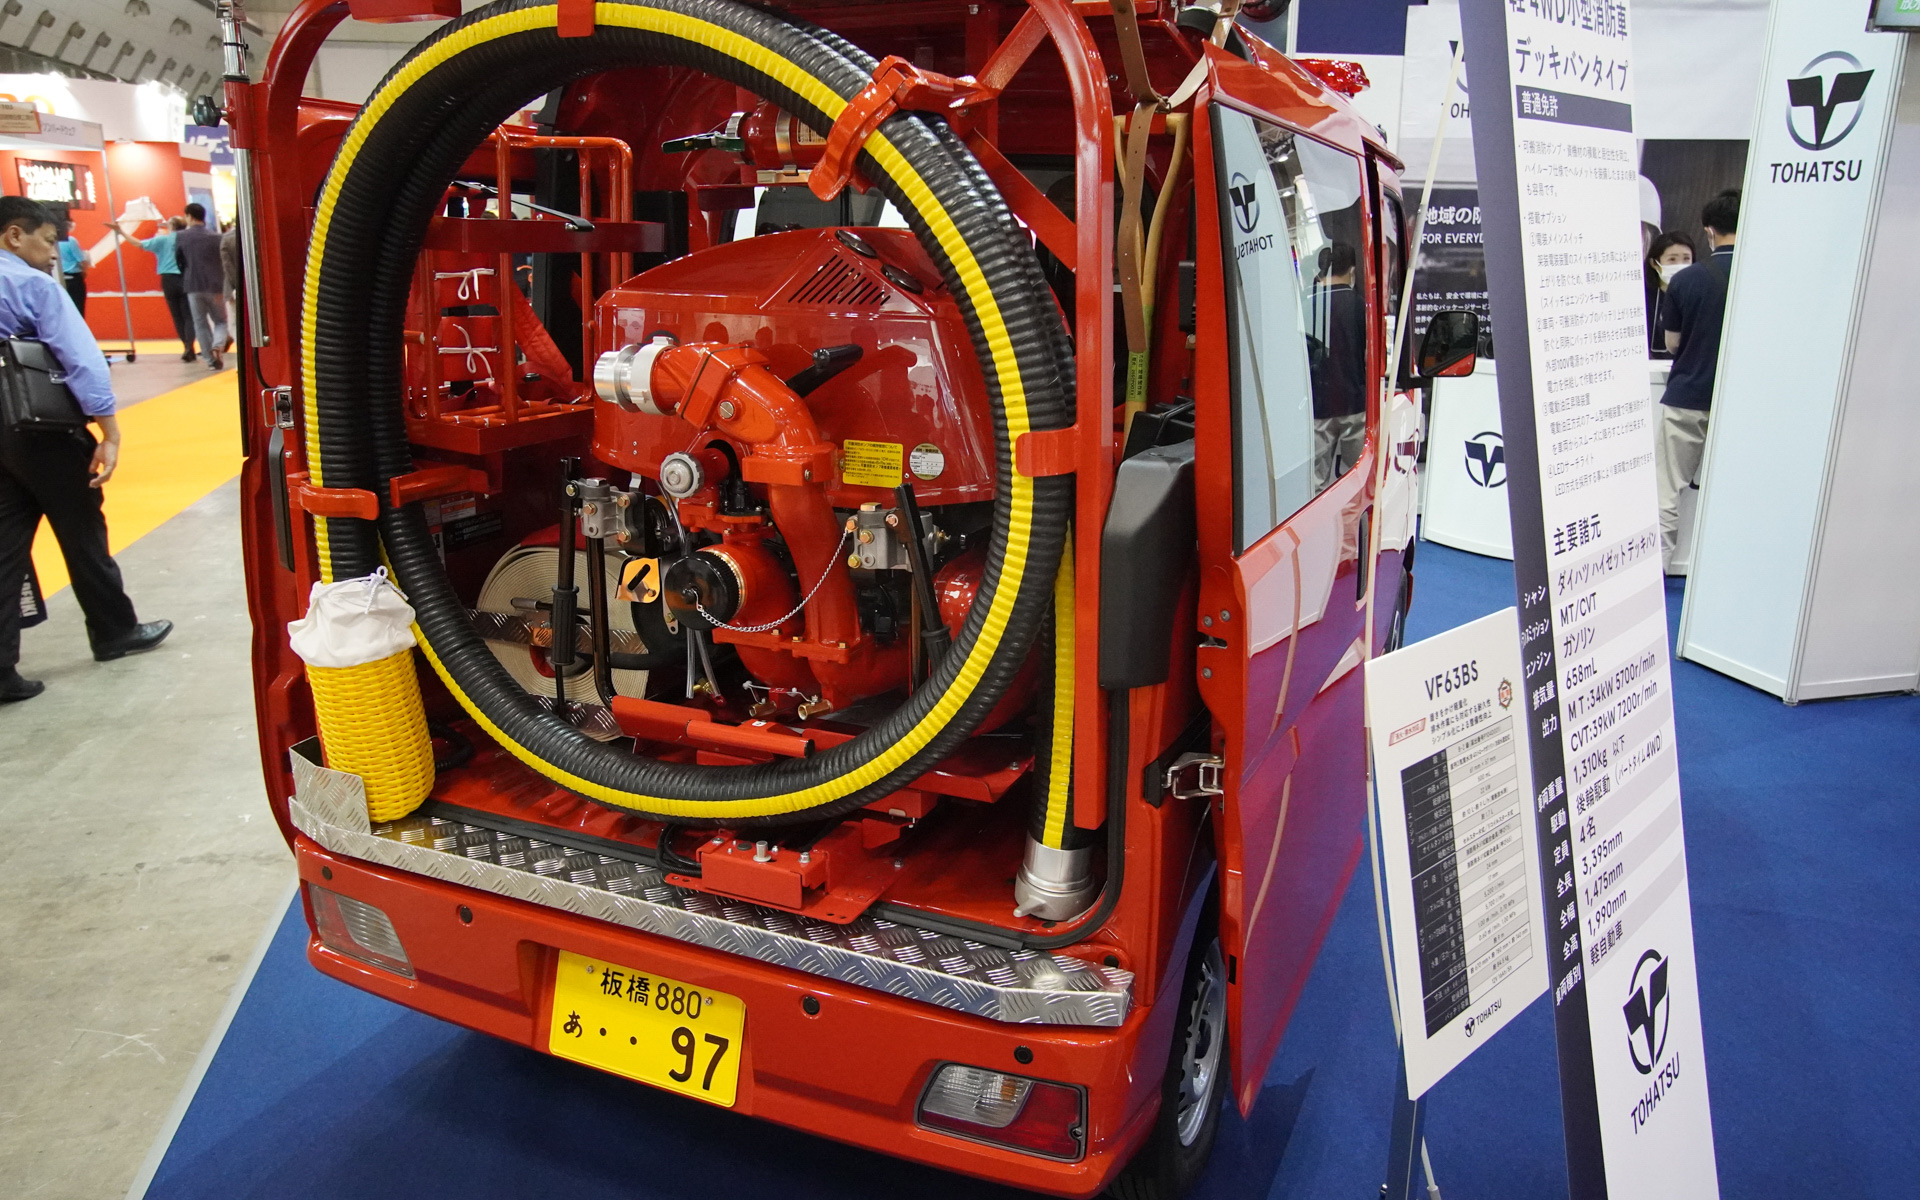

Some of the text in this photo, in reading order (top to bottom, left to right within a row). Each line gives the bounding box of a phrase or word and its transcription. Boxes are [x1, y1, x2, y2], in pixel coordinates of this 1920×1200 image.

[1515, 36, 1628, 91] デッキバンタイプ
[1521, 91, 1558, 117] 普通免許
[1771, 160, 1862, 183] TOHATSU
[1421, 233, 1442, 244] FOR
[1553, 514, 1601, 556] 主要諸元
[1524, 585, 1546, 609] シャシ
[1560, 592, 1597, 627] MT/CVT
[1526, 627, 1595, 679] エンジン ガソリン
[1566, 657, 1598, 690] 658mL
[1425, 659, 1479, 701] VF63BS
[1541, 714, 1557, 738] 出力
[1615, 651, 1656, 690] 5700r/min
[1570, 680, 1658, 752] CVT:39kW 7200r/min
[1573, 748, 1608, 785] 1,310kg
[1612, 734, 1625, 757] 以下
[1576, 774, 1611, 816] 後輪駆動
[1553, 815, 1596, 866] 定員 4名
[1556, 830, 1623, 898] 全長 3,395mm
[1559, 861, 1624, 929] 全幅 1,475mm
[1562, 889, 1627, 961] 全高 1,990mm
[1590, 920, 1624, 967] 軽自動車
[600, 968, 702, 1019] 板橋 880
[1476, 998, 1501, 1025] TOHATSU
[563, 1010, 729, 1091] あ 97
[1631, 1051, 1680, 1135] TOHATSU
